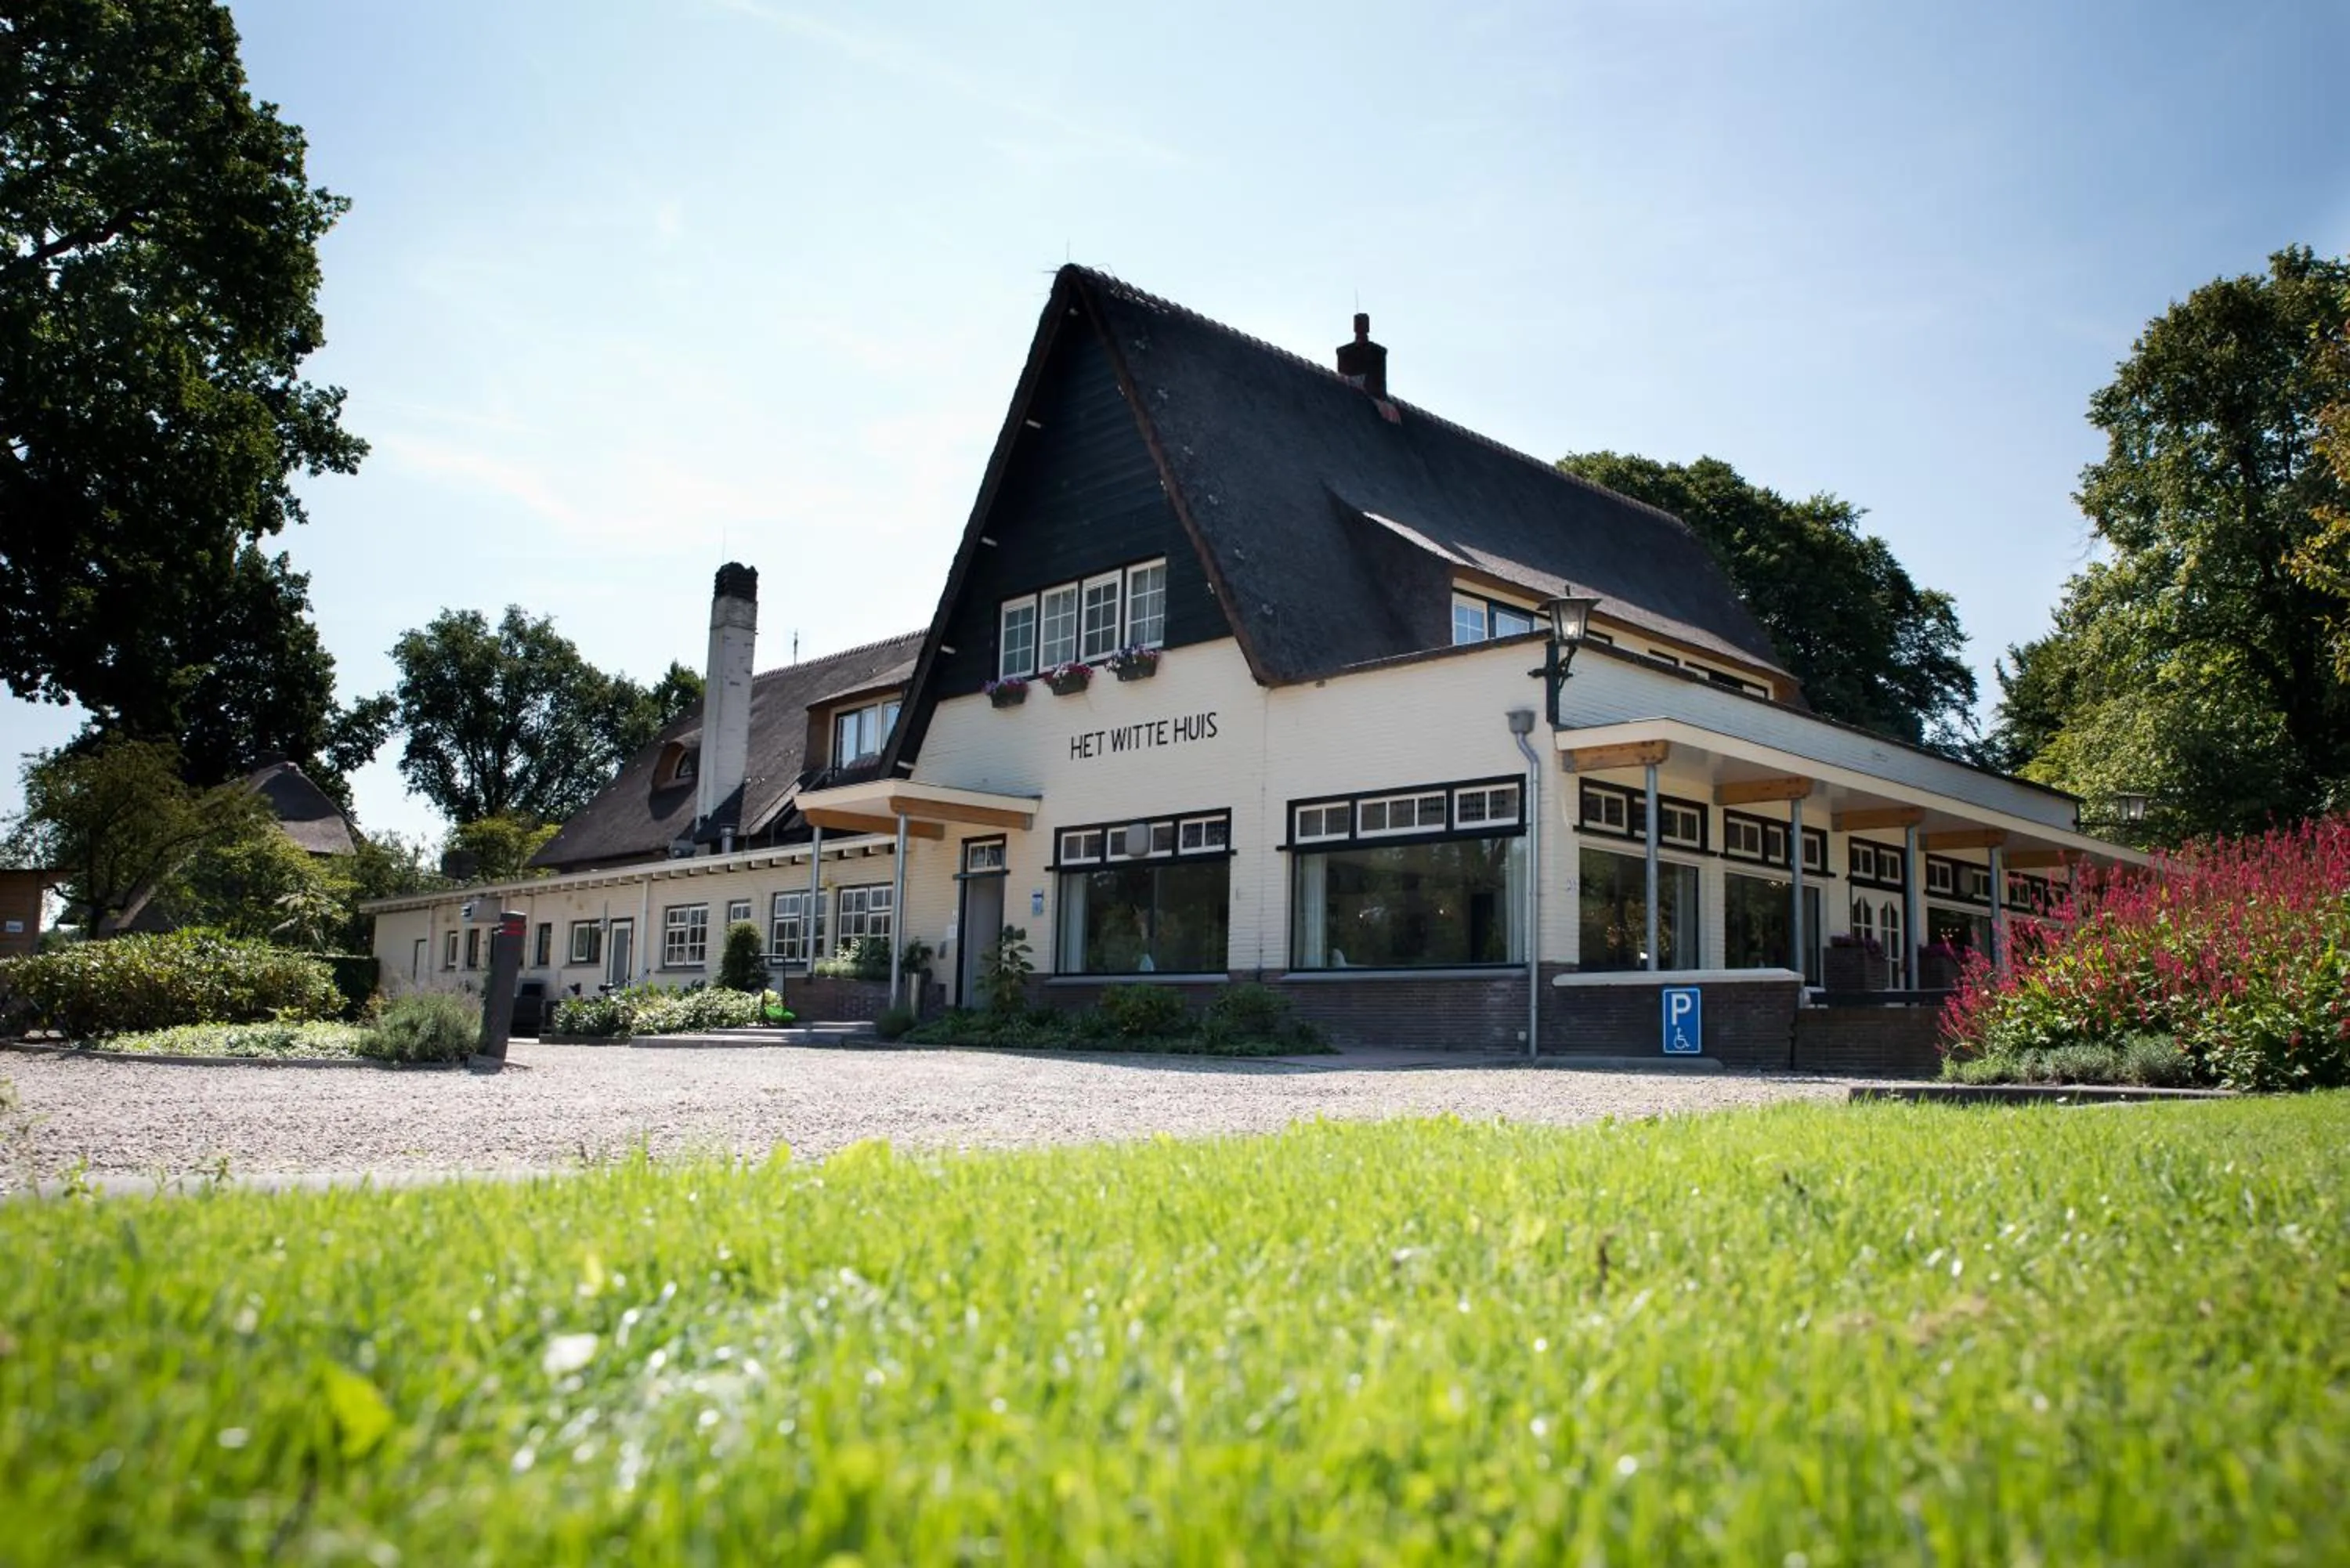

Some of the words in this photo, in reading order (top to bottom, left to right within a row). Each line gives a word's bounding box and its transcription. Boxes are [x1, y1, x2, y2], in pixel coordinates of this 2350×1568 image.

[1071, 731, 1105, 761] HET
[1111, 721, 1168, 752] WITTE
[1174, 712, 1217, 743] HUIS
[1672, 993, 1692, 1025] P
